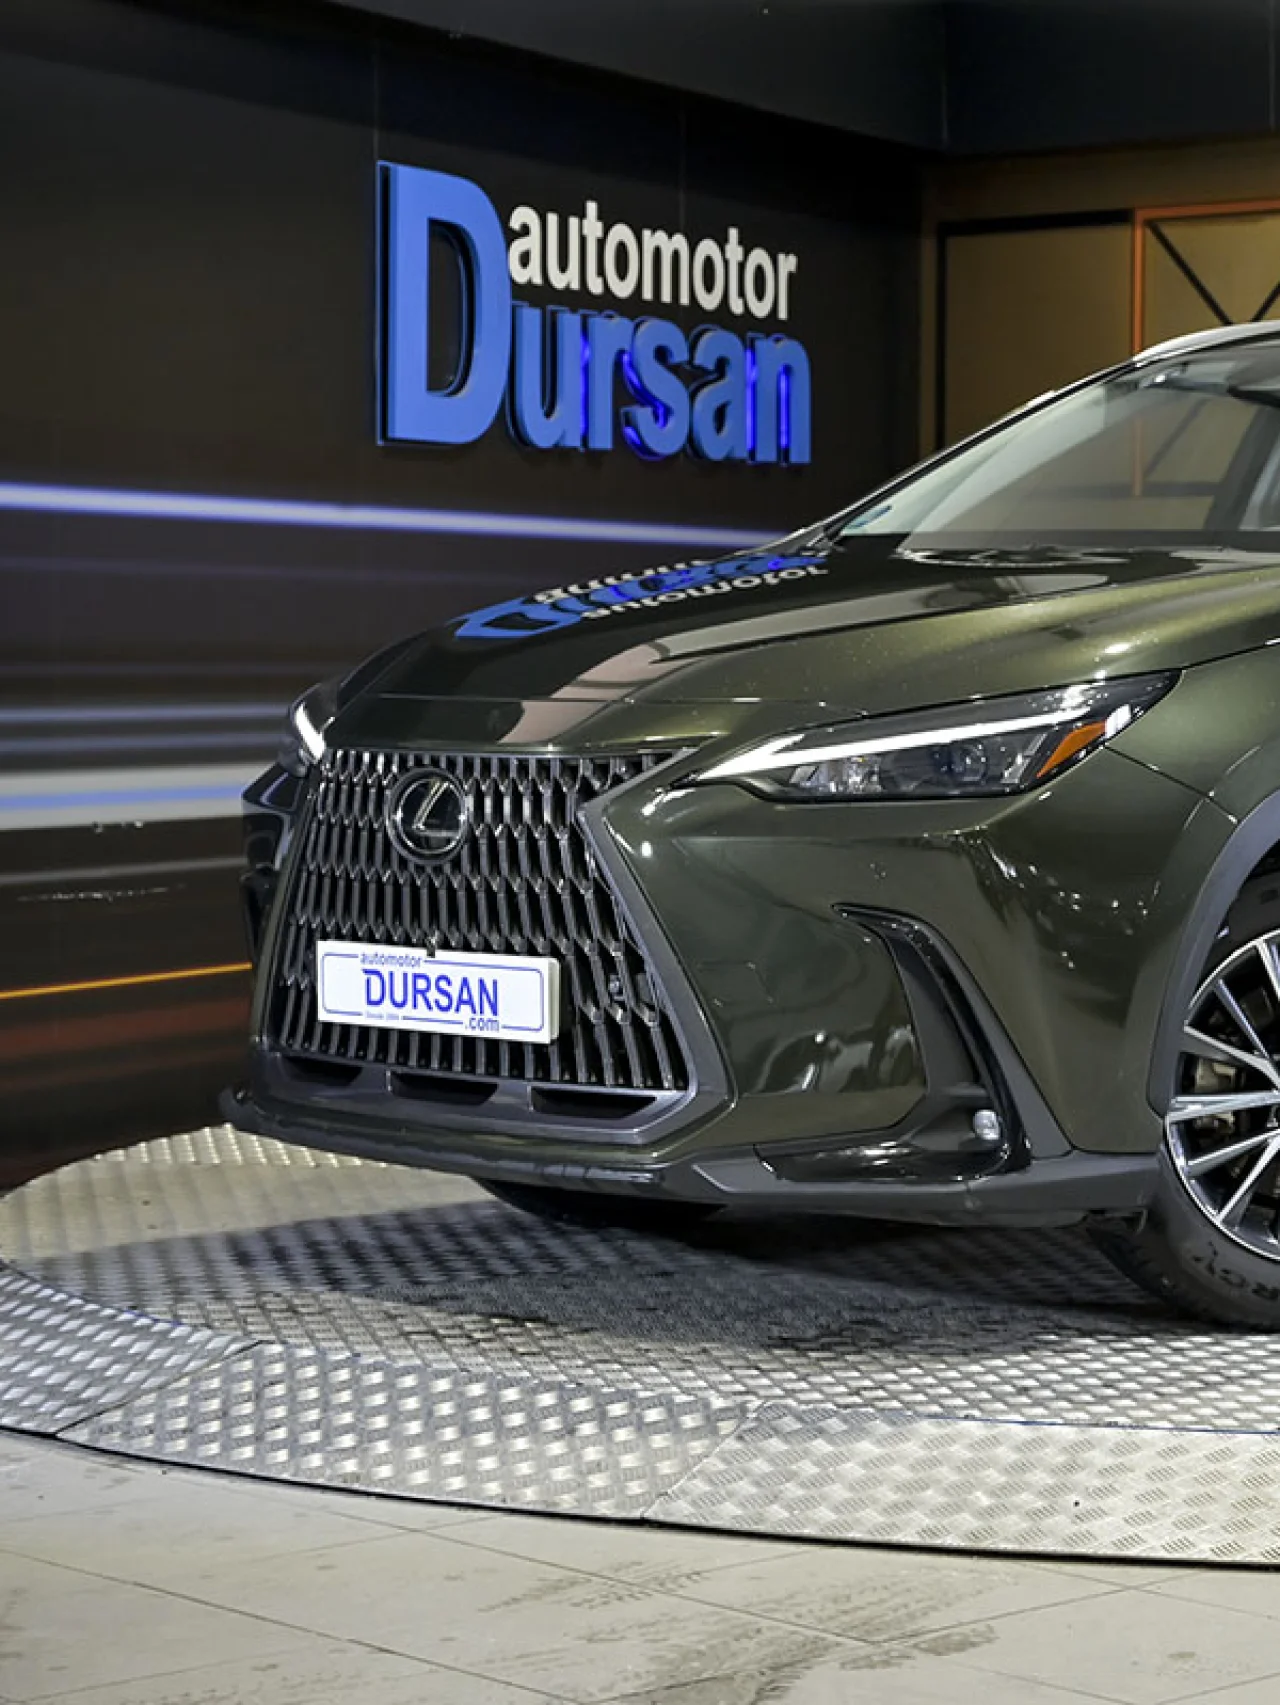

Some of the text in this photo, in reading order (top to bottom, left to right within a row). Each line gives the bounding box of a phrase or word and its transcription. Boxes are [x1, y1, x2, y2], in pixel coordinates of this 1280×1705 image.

[508, 201, 798, 321] automotor
[376, 159, 812, 466] Dursan
[359, 951, 422, 968] automotor
[362, 968, 498, 1017] DURSAN
[464, 1016, 500, 1032] .com
